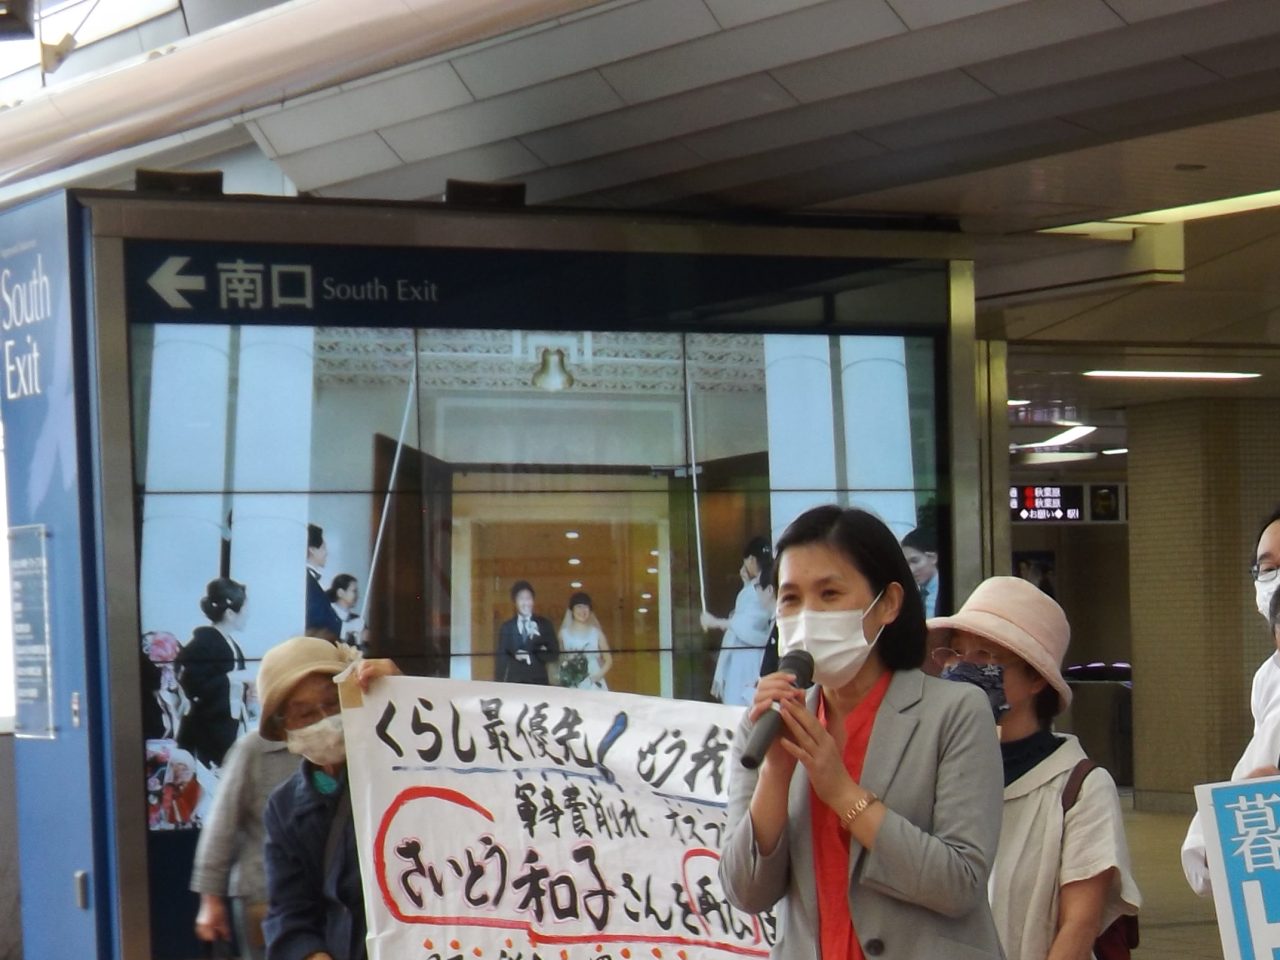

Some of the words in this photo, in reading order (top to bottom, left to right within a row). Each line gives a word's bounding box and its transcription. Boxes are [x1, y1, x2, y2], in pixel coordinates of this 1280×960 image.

[2, 253, 51, 331] South
[217, 259, 314, 309] 南口
[322, 276, 388, 301] South
[397, 278, 439, 302] Exit
[5, 334, 41, 400] Exit
